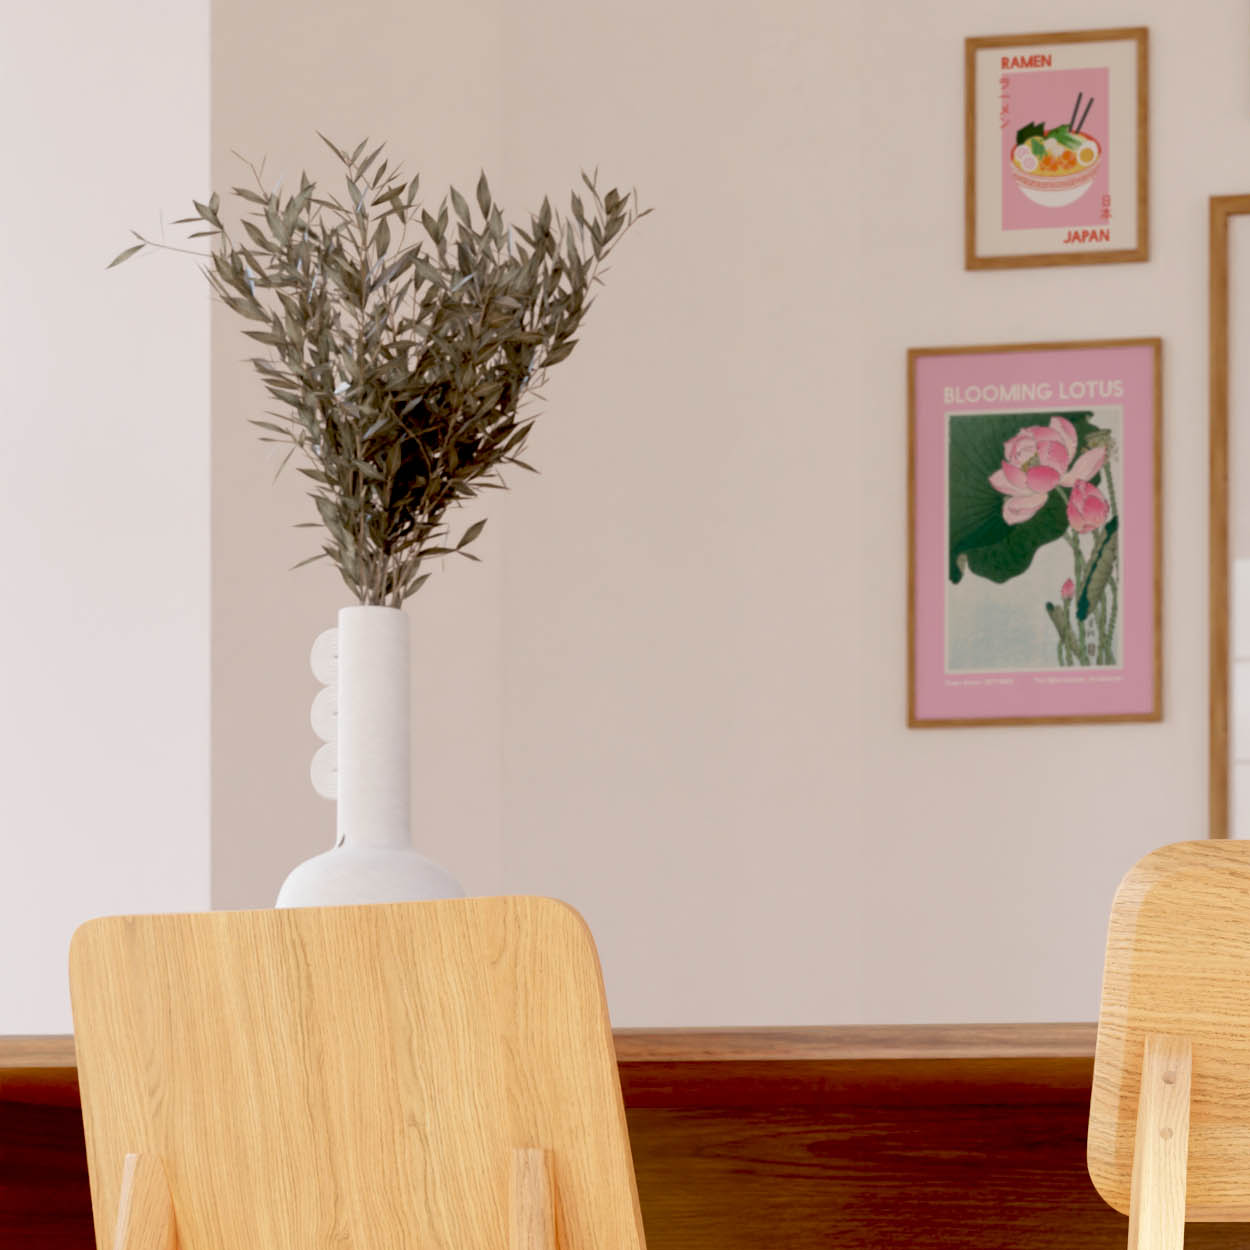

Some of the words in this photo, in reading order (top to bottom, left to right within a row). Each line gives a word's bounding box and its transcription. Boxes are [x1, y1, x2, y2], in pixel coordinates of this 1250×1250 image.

[1001, 55, 1051, 69] RAMEN
[1064, 229, 1110, 243] JAPAN
[944, 382, 1052, 404] BLOOMING
[1059, 380, 1124, 399] LOTUS
